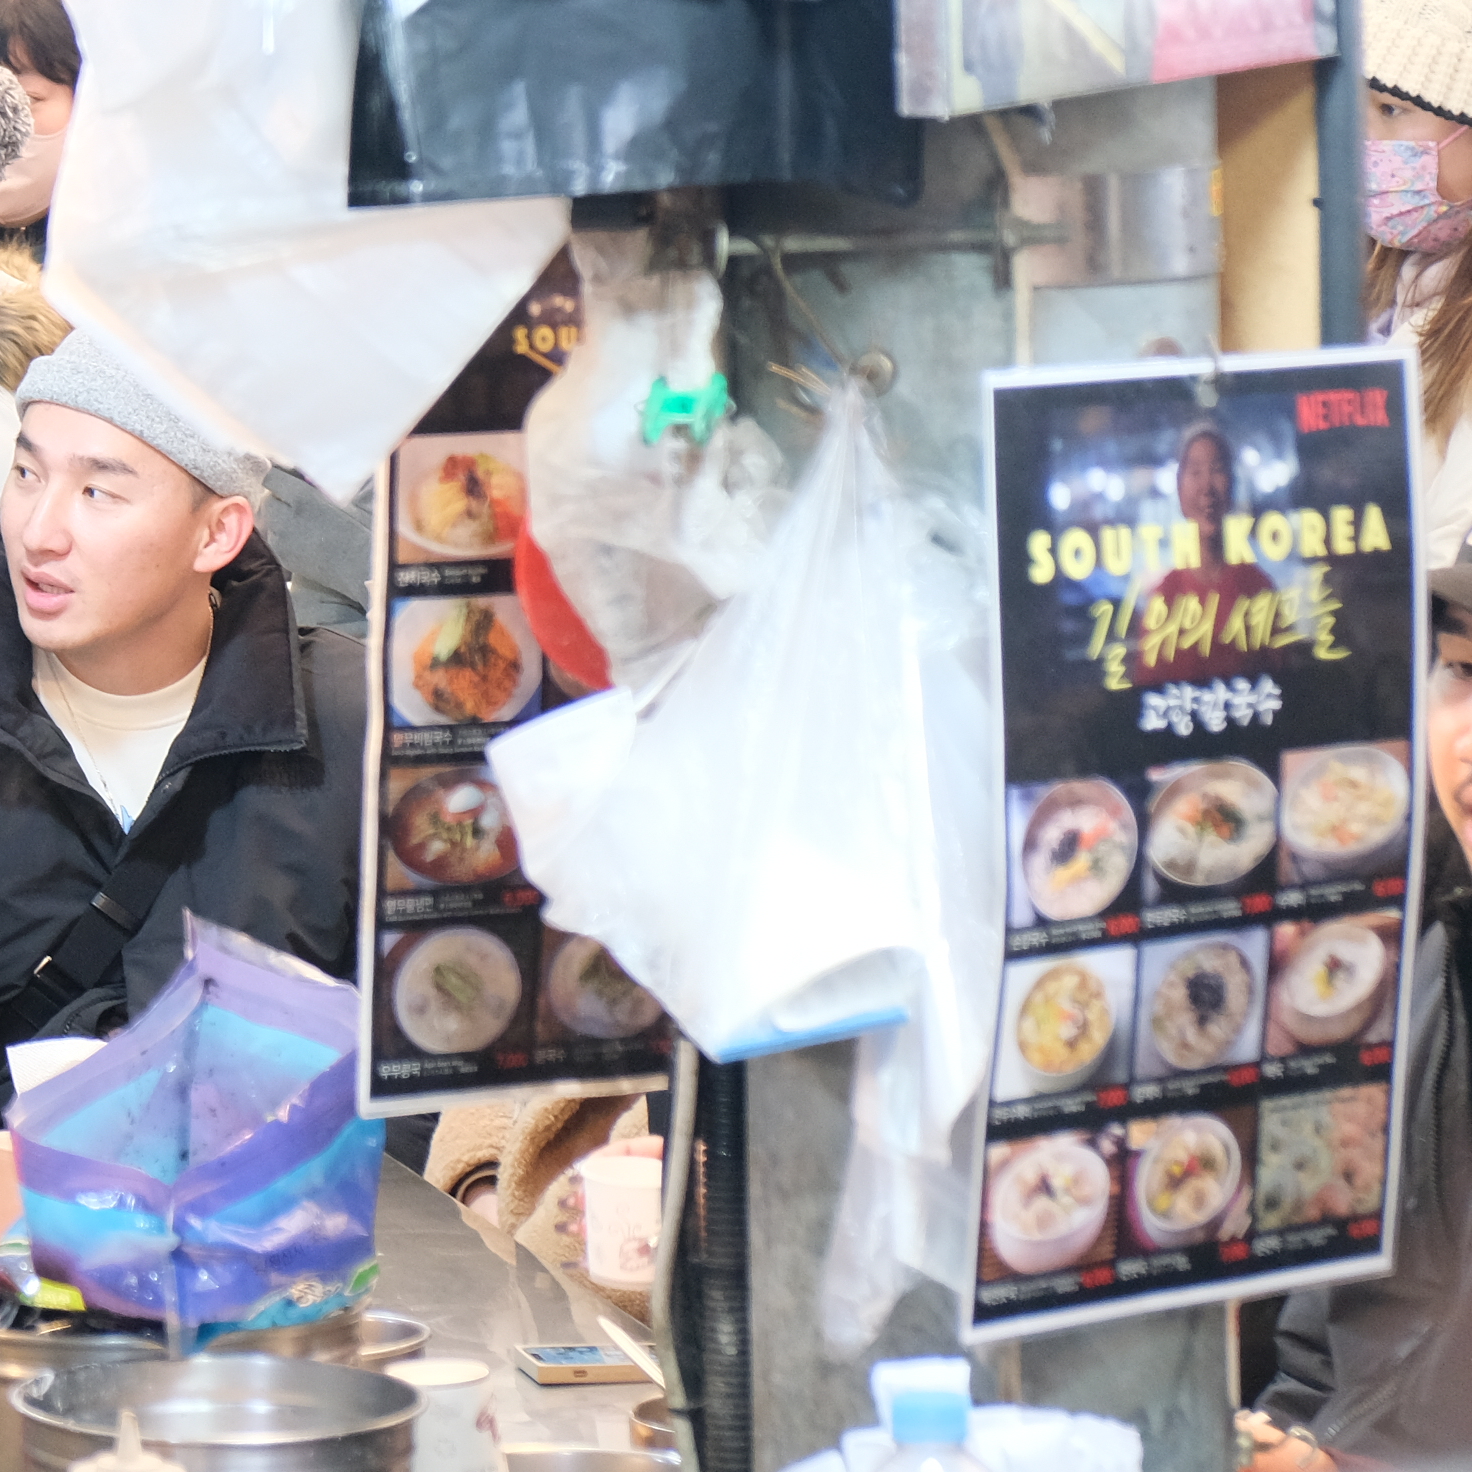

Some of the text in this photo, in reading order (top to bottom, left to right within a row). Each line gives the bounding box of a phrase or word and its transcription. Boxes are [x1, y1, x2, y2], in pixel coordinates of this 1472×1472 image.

[513, 324, 578, 357] SOU
[1294, 387, 1391, 434] NETFLIX
[1026, 500, 1393, 587] SOUTH KOREA
[1087, 573, 1141, 692] 길
[1139, 588, 1220, 669] 위의
[1139, 672, 1284, 737] 고향칼국수
